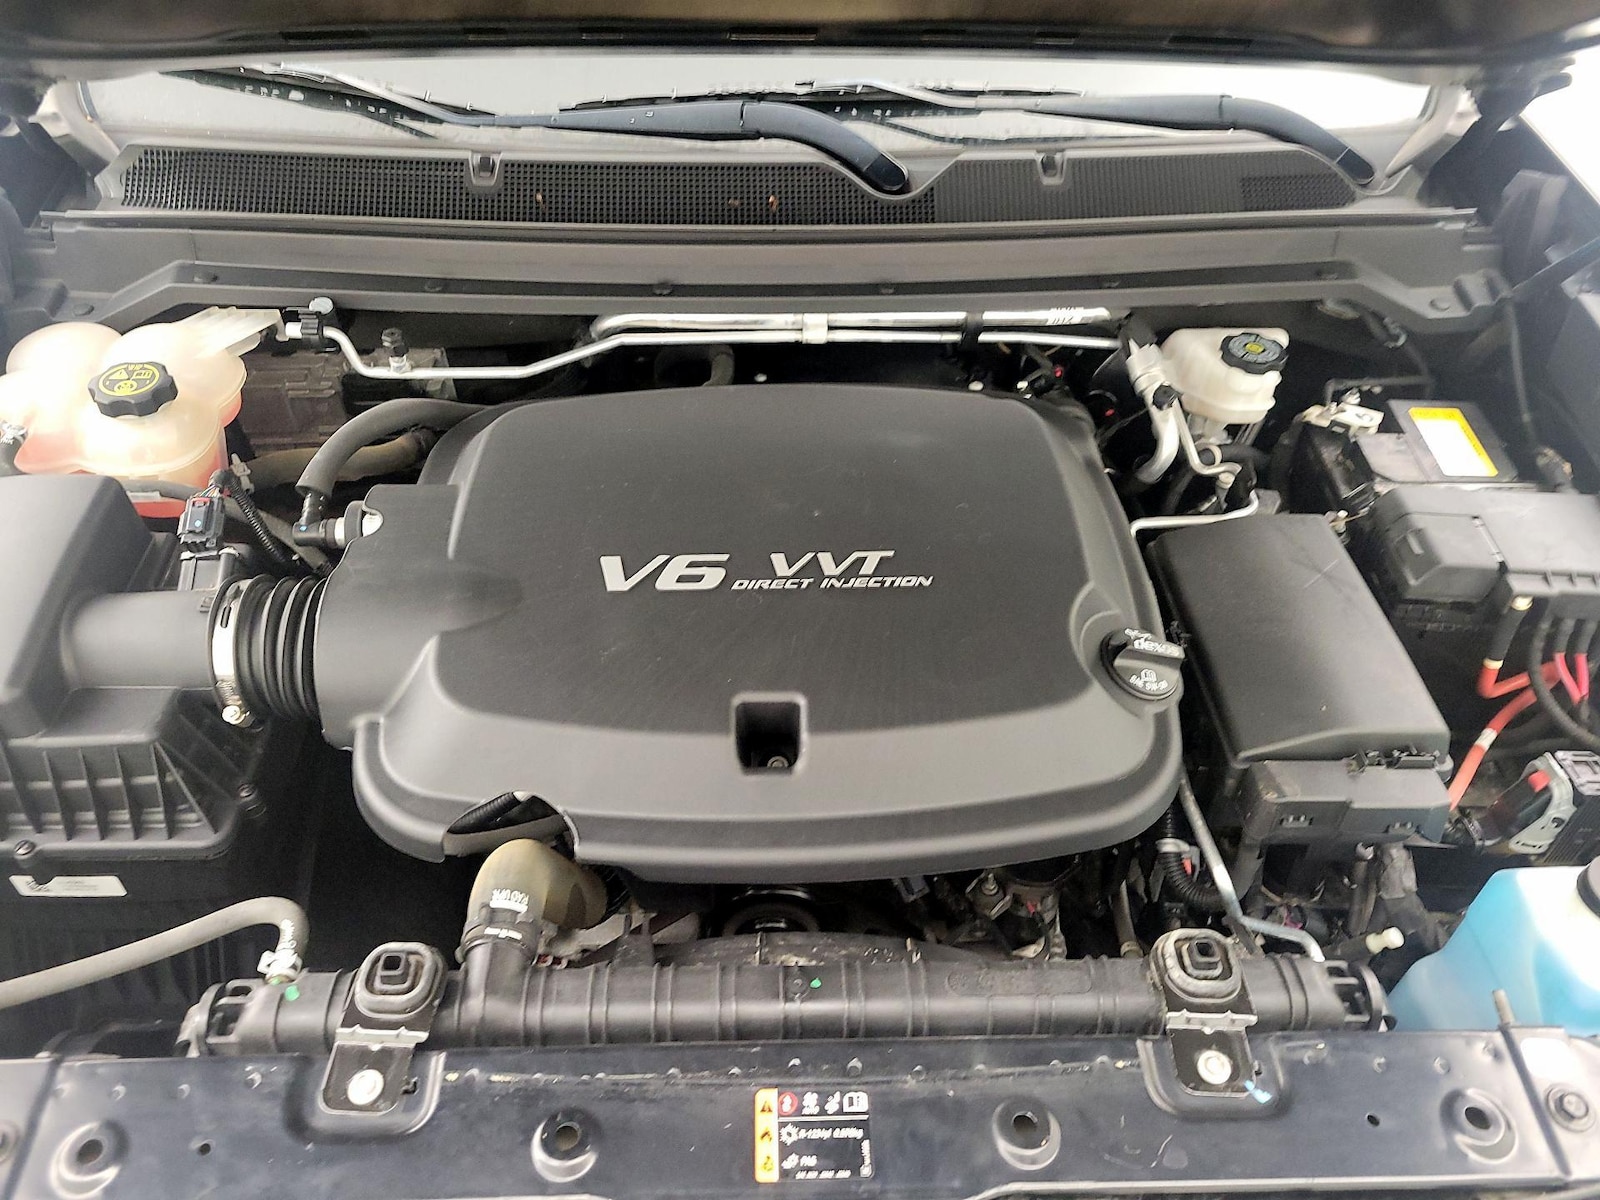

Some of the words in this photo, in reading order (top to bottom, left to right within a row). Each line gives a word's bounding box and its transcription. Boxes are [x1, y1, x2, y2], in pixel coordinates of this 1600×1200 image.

[599, 553, 731, 592] V6
[769, 550, 895, 577] VVT
[731, 577, 815, 591] DIRECT
[820, 575, 934, 590] INJECTION
